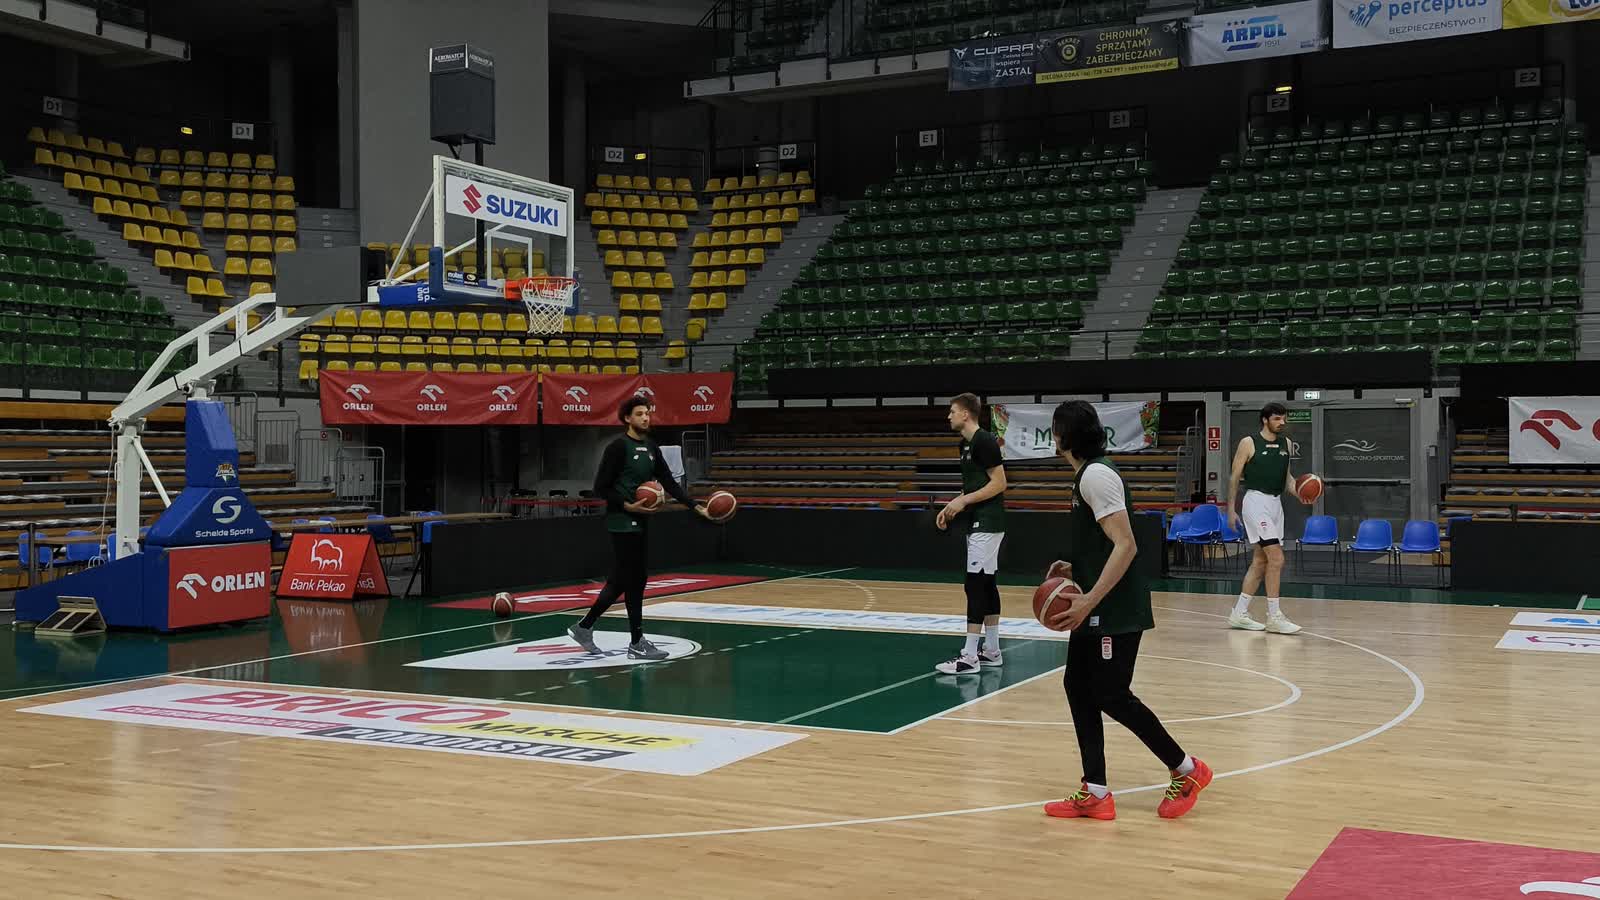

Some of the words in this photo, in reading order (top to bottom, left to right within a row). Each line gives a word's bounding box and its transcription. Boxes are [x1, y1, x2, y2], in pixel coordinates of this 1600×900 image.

[1389, 0, 1487, 21] perceptus
[1478, 16, 1487, 24] IT
[1099, 27, 1150, 41] CHRONIMY
[1222, 24, 1287, 43] ARPOL
[974, 43, 1034, 56] CUPRA
[1095, 38, 1153, 52] SPRZĄTAMY
[1264, 40, 1280, 48] 1991
[1086, 47, 1163, 65] ZABEZPIECZAMY
[995, 59, 1020, 67] wspiera
[995, 66, 1033, 78] ZASTAL
[1520, 71, 1537, 83] E2
[46, 99, 63, 113] D1
[1271, 98, 1287, 108] E2
[1113, 112, 1127, 125] E1
[235, 126, 250, 136] D1
[922, 134, 934, 143] E1
[608, 150, 622, 160] D2
[782, 147, 795, 157] D2
[486, 194, 558, 227] SUZUKI
[342, 402, 374, 411] ORLEN
[417, 403, 447, 412] ORLEN
[489, 404, 517, 412] ORLEN
[562, 404, 591, 412] ORLEN
[690, 403, 715, 412] ORLEN
[195, 529, 228, 538] Schelde
[229, 527, 254, 537] Sports
[211, 571, 265, 593] ORLEN
[290, 578, 315, 591] Bank
[316, 579, 346, 592] Pekao
[784, 611, 1042, 628] percepu
[173, 690, 512, 725] BRICO
[458, 721, 673, 747] MARCHE
[323, 726, 605, 761] POMORSKIE
